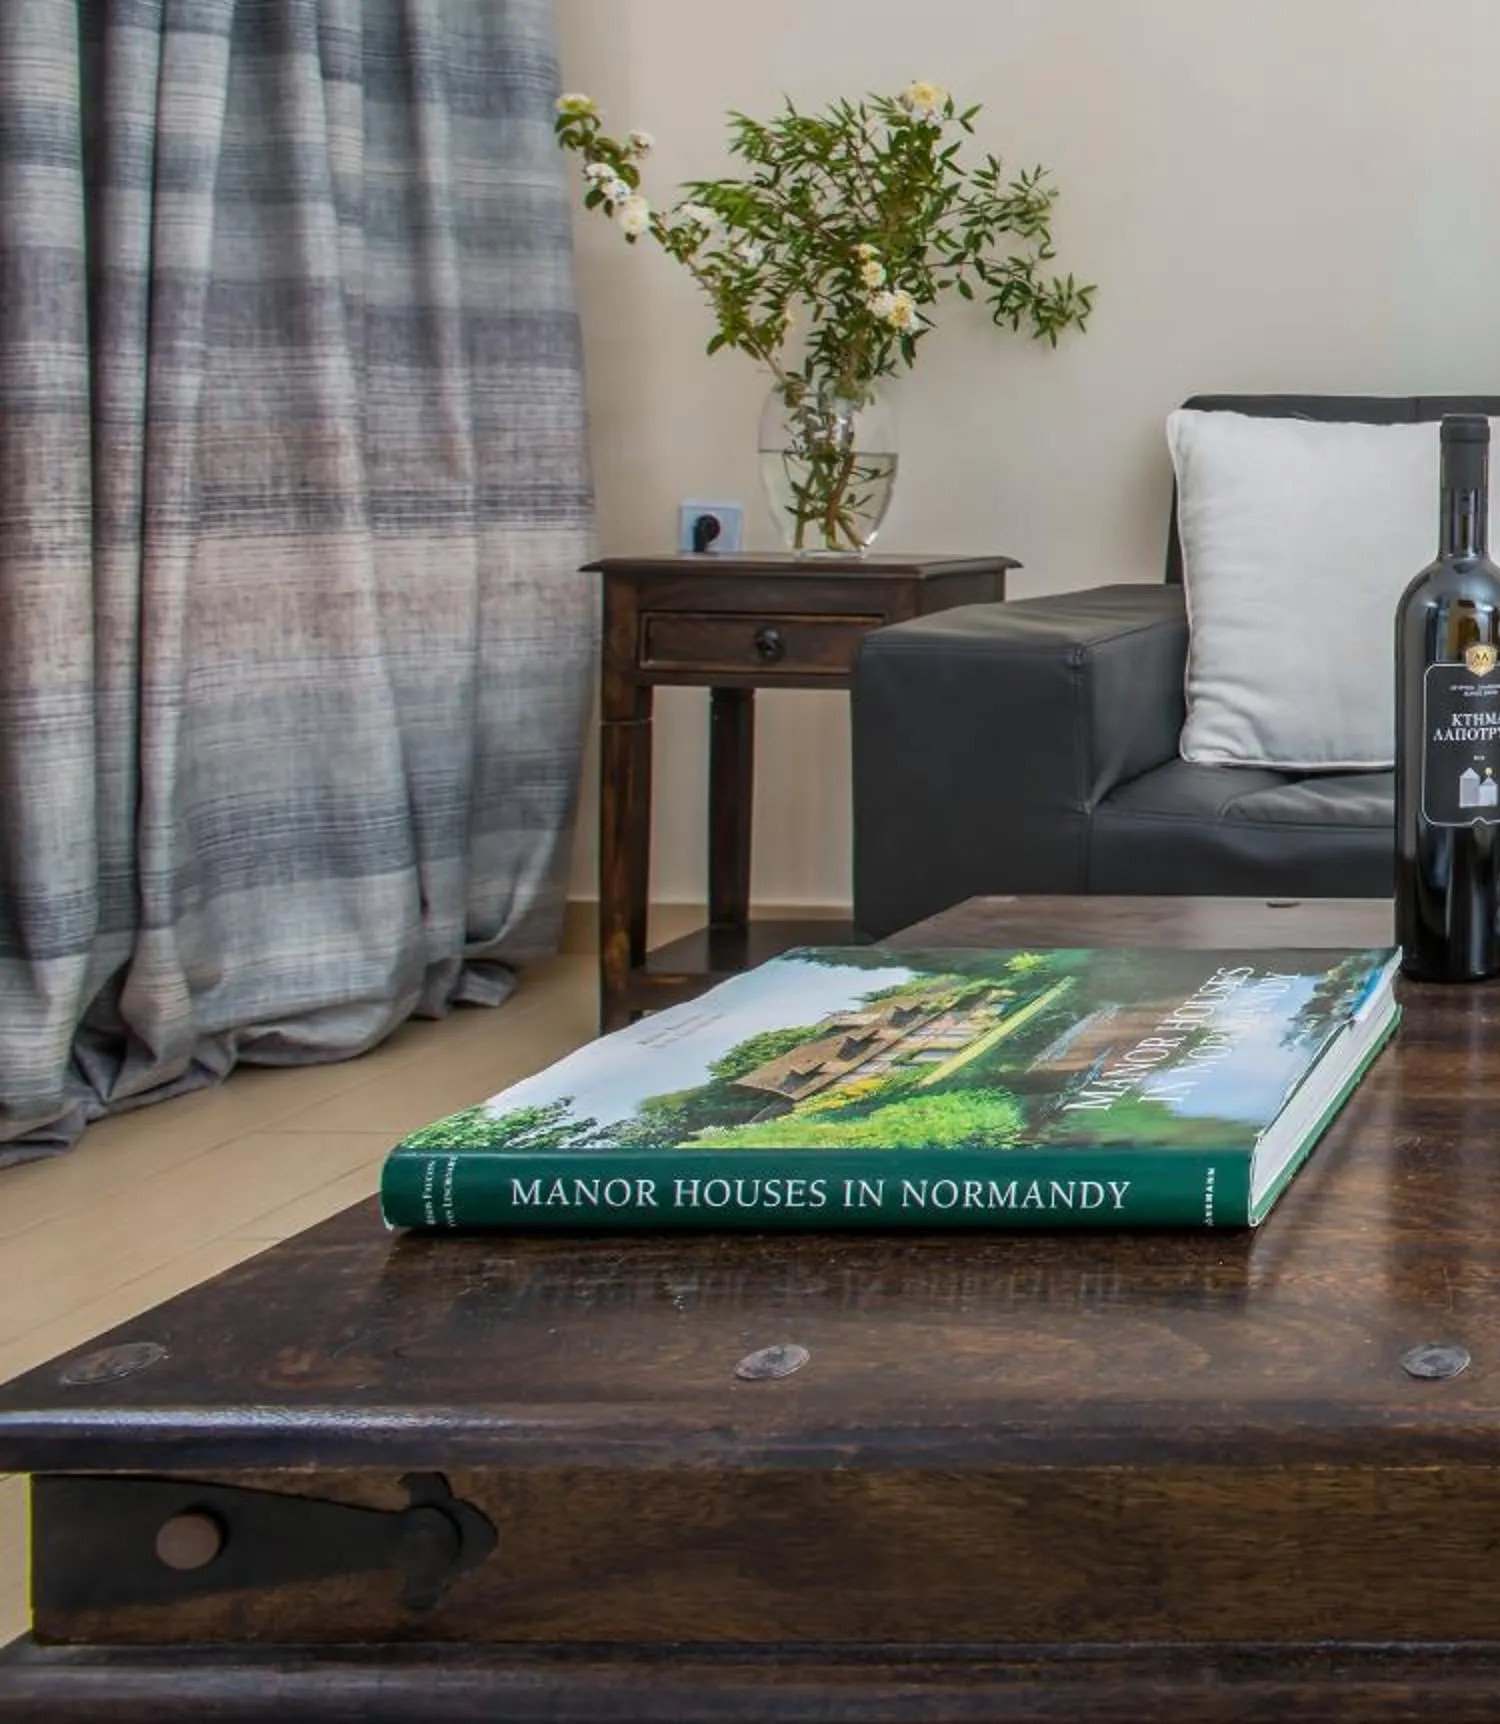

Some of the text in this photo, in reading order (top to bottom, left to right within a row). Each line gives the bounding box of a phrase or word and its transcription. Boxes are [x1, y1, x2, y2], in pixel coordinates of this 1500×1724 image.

[1061, 966, 1254, 1111] MANOR HOUSES
[510, 1178, 1132, 1209] MANOR HOUSES IN NORMANDY
